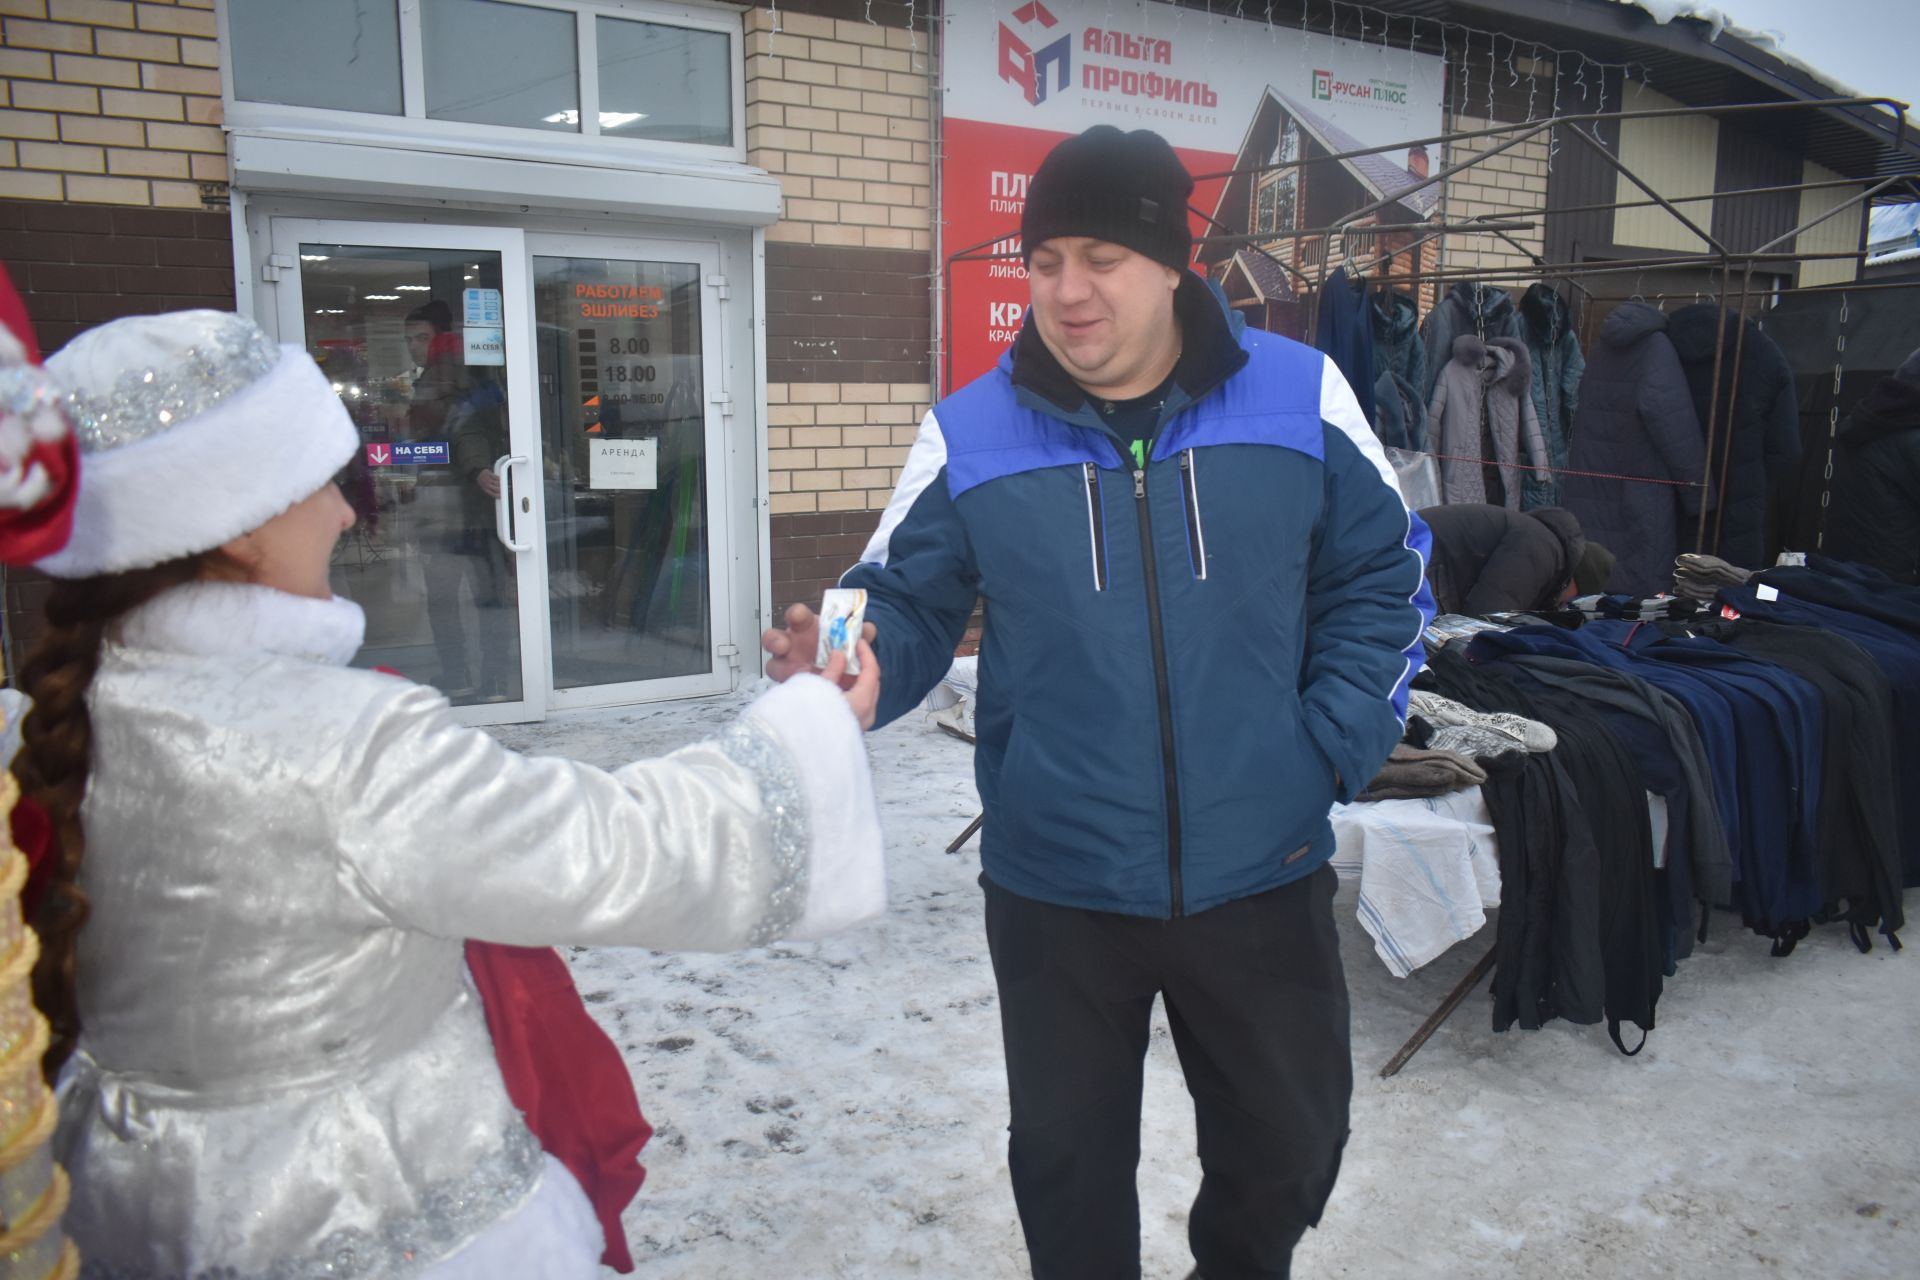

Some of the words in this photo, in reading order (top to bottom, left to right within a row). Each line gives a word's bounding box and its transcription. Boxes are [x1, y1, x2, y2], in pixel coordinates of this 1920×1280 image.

[1083, 27, 1172, 65] АЛЬТА
[1082, 63, 1218, 109] ПРОФИЛЬ
[1333, 81, 1371, 99] РУСАН
[1373, 87, 1407, 105] ПЛЮС
[991, 171, 1034, 199] ПЛ
[575, 284, 663, 299] РАБОТАЕМ
[581, 303, 658, 318] ЭШЛИБЕЗ
[471, 343, 481, 351] НА
[609, 338, 650, 354] 8.00
[605, 365, 656, 382] 18.00
[395, 446, 412, 455] НА
[414, 446, 443, 454] СЕБЯ
[601, 448, 646, 458] АРЕНДА
